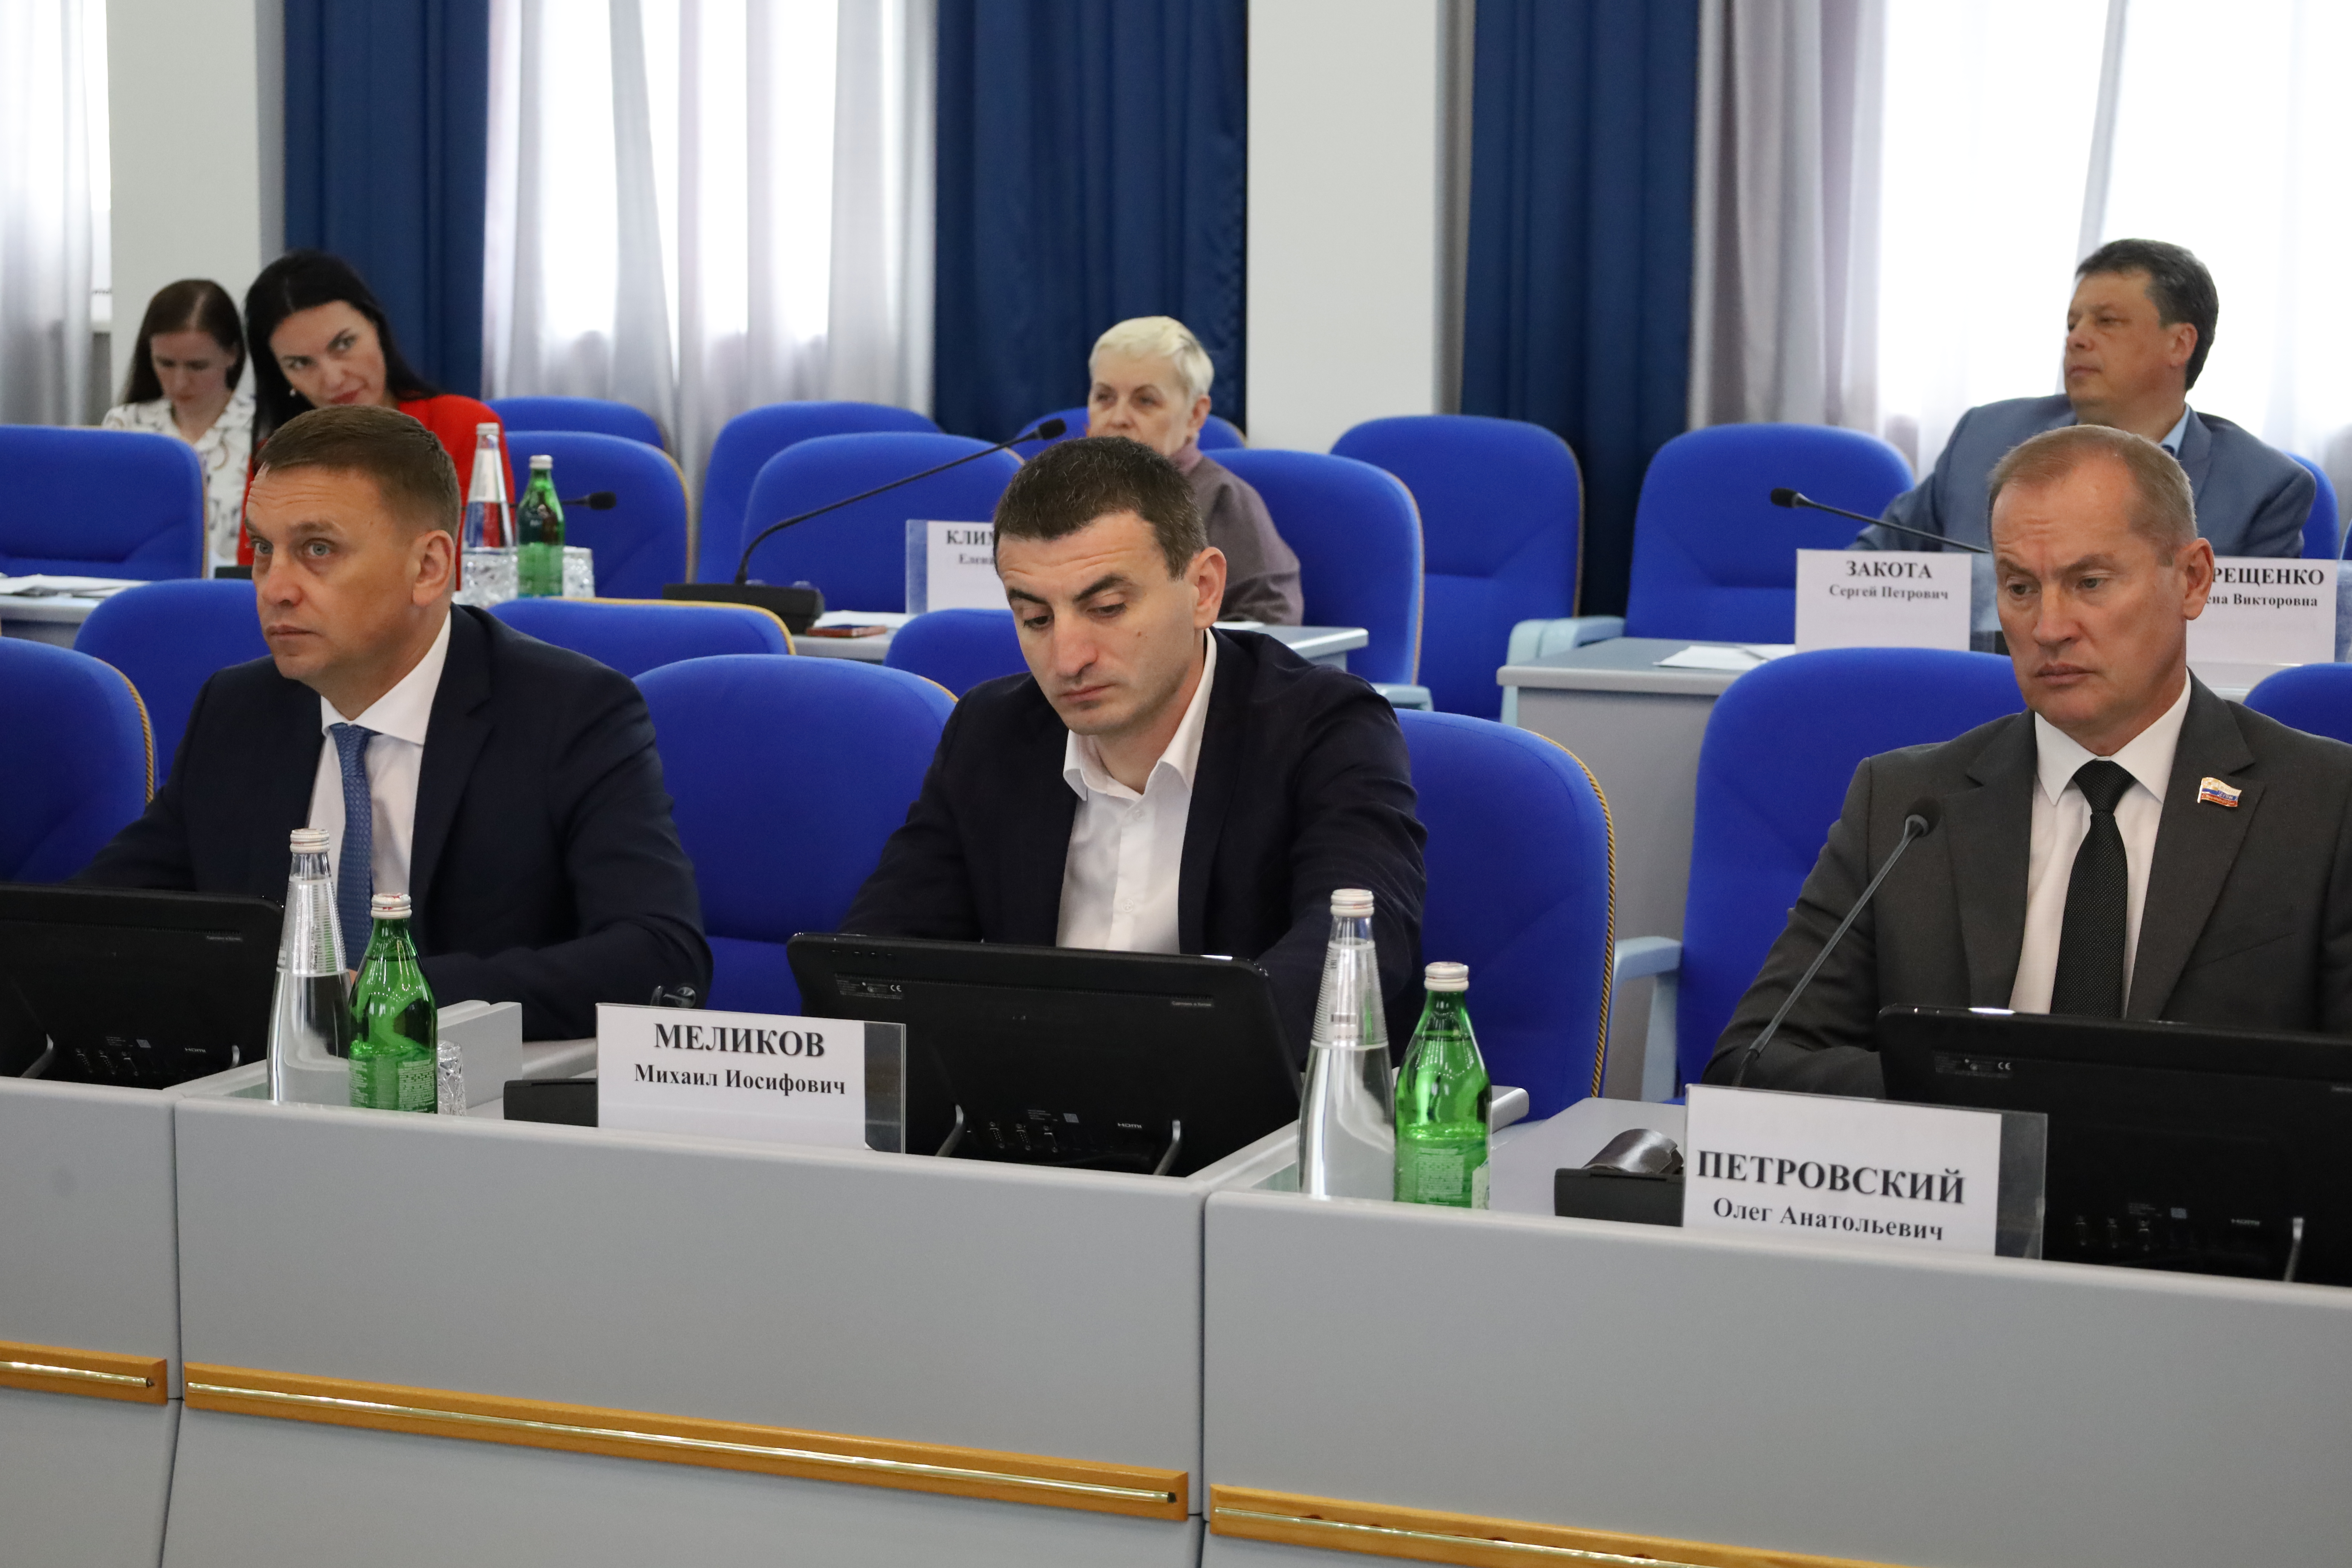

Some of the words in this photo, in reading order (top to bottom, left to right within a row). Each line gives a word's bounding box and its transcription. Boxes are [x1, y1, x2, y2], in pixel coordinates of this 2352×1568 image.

[1846, 560, 1932, 579] ЗАКОТА
[2213, 567, 2324, 587] РЕЩЕНКО
[1829, 585, 1877, 599] Сергей
[1882, 586, 1948, 601] Петрович
[2207, 596, 2228, 604] ена
[2234, 593, 2317, 609] Викторовна
[654, 1023, 825, 1057] МЕЛИКОВ
[634, 1063, 718, 1086] Михаил
[724, 1069, 845, 1096] Иосифович
[1697, 1150, 1966, 1204] ПЕТРОВСКИЙ
[1713, 1197, 1773, 1222] Олег
[1779, 1205, 1944, 1240] Анатольевич
